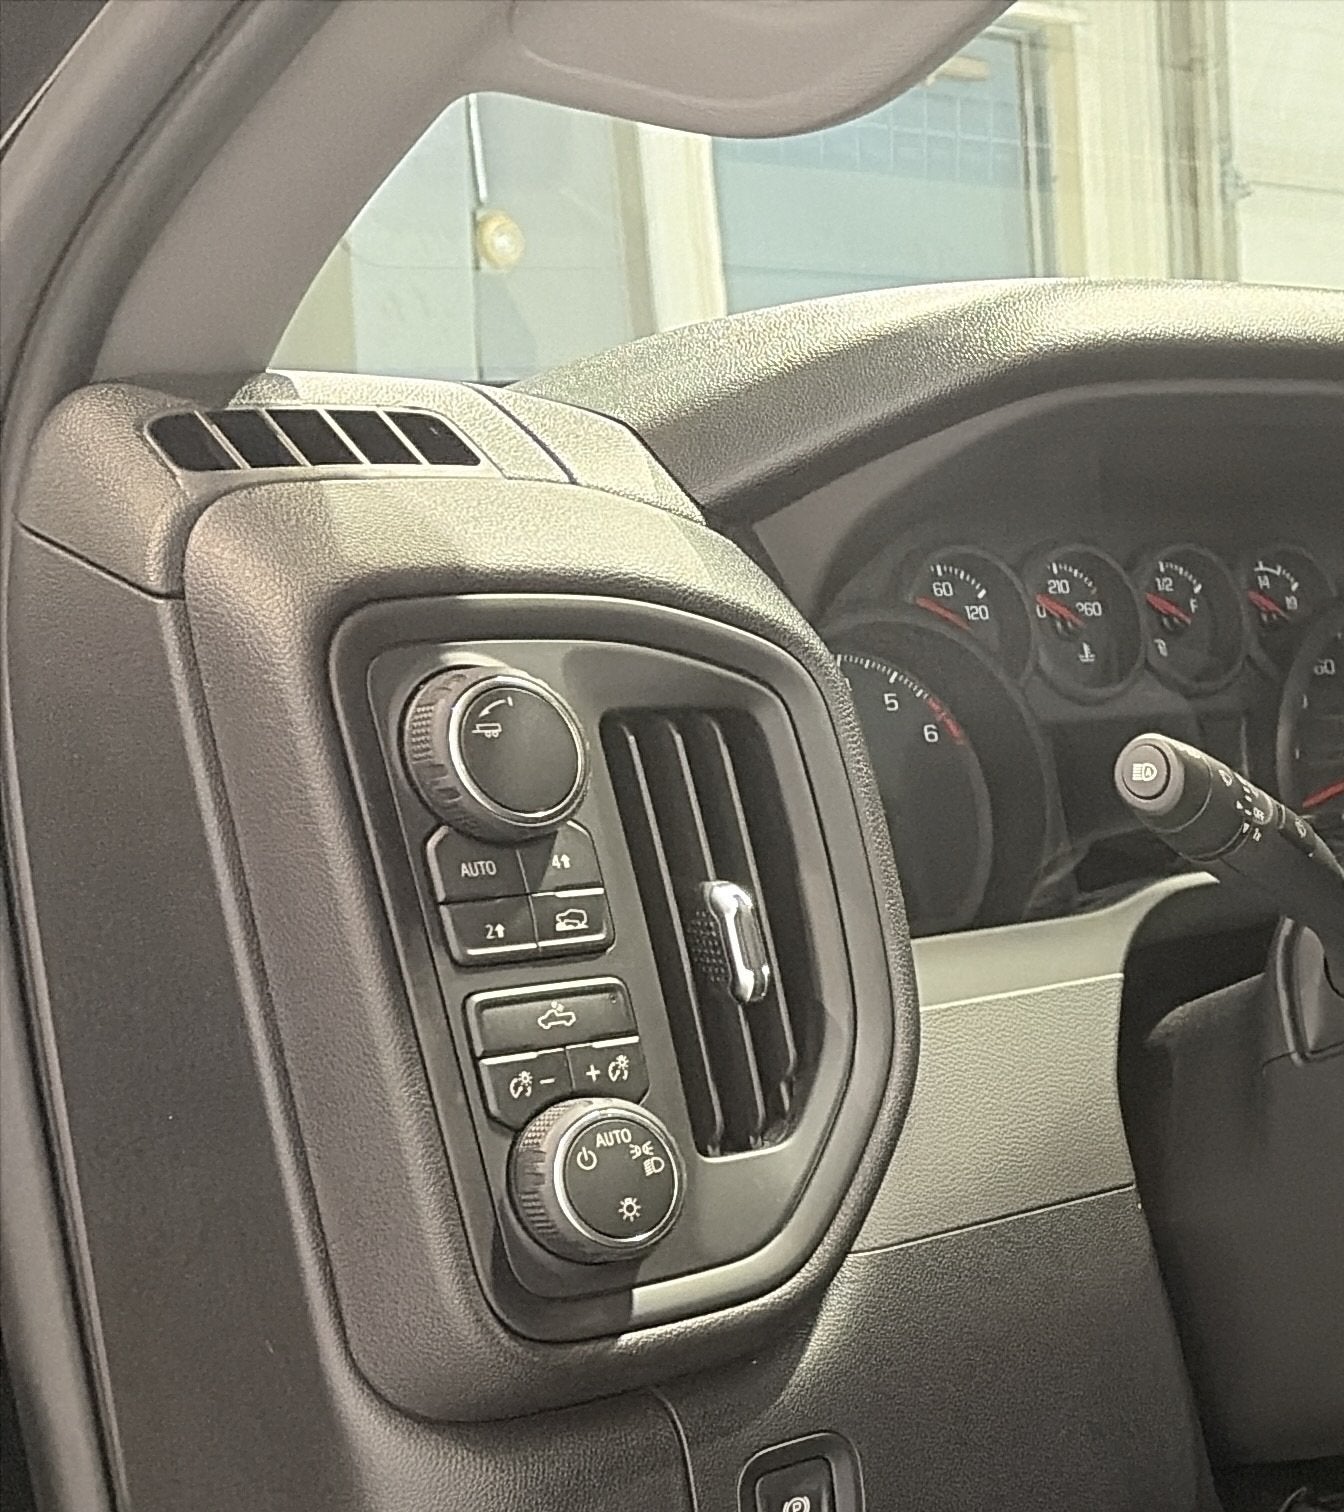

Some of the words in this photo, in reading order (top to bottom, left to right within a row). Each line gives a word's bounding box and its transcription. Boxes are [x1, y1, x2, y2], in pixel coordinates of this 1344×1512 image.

[933, 582, 953, 597] 60
[1049, 579, 1070, 594] 210
[965, 605, 989, 620] 120
[1190, 598, 1199, 614] F
[884, 693, 899, 711] 5
[923, 724, 939, 742] 6
[461, 860, 497, 878] AUTO
[551, 855, 561, 869] 4
[485, 924, 496, 939] 2
[596, 1128, 632, 1148] AUTO
